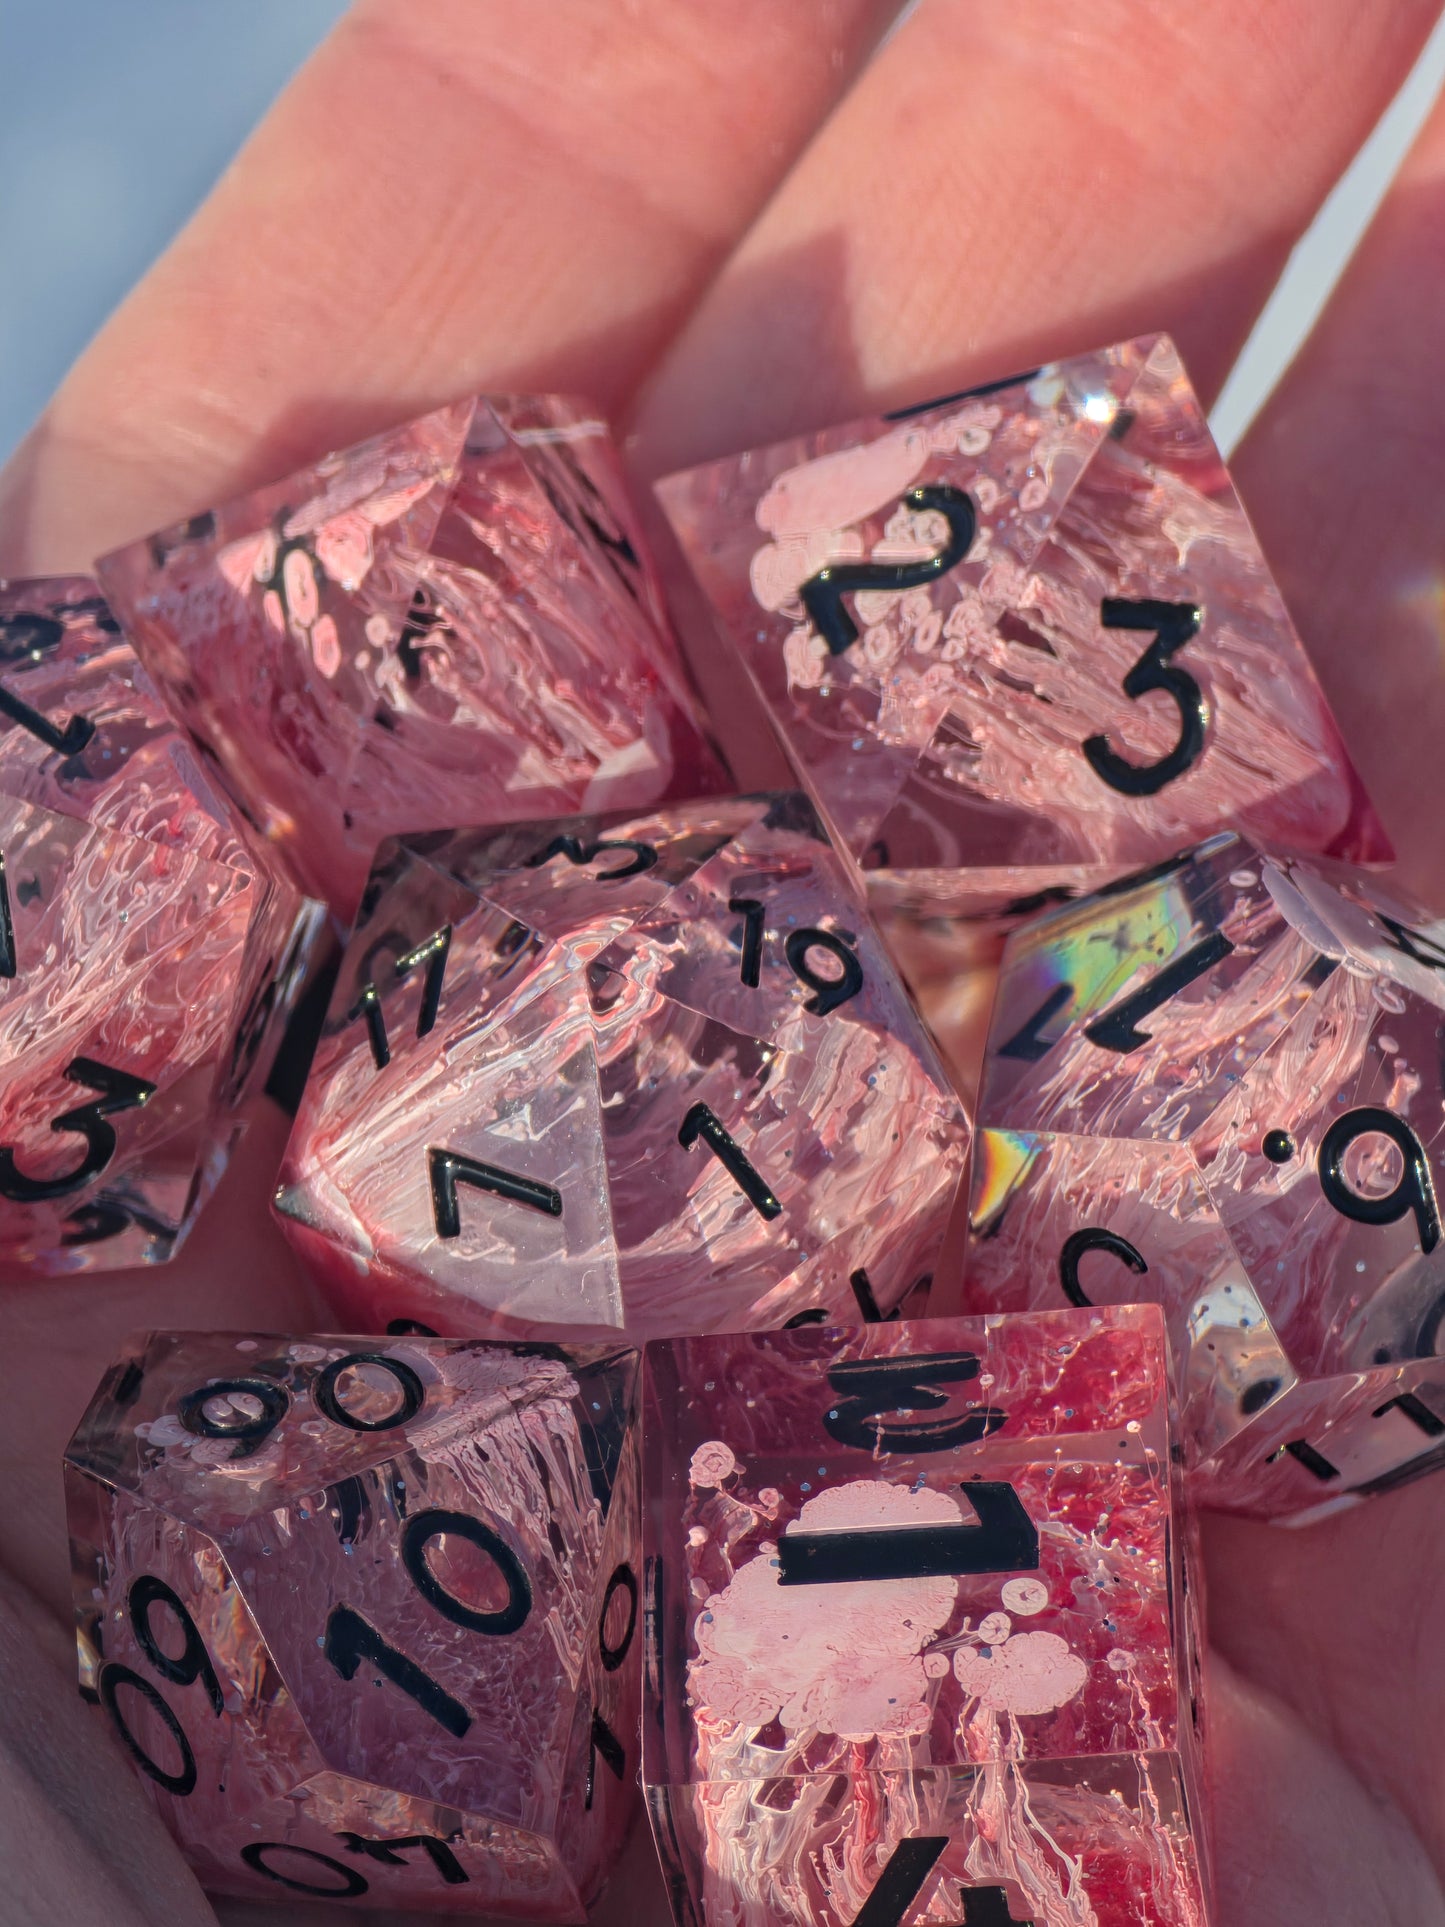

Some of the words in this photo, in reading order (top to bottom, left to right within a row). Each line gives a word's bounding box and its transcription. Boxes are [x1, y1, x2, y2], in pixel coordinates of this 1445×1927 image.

[801, 484, 977, 656] 2
[1083, 597, 1208, 797] 3
[429, 1144, 564, 1239] 7
[678, 1102, 783, 1222] 1
[777, 1480, 1040, 1586] 1
[324, 1508, 533, 1739] 10
